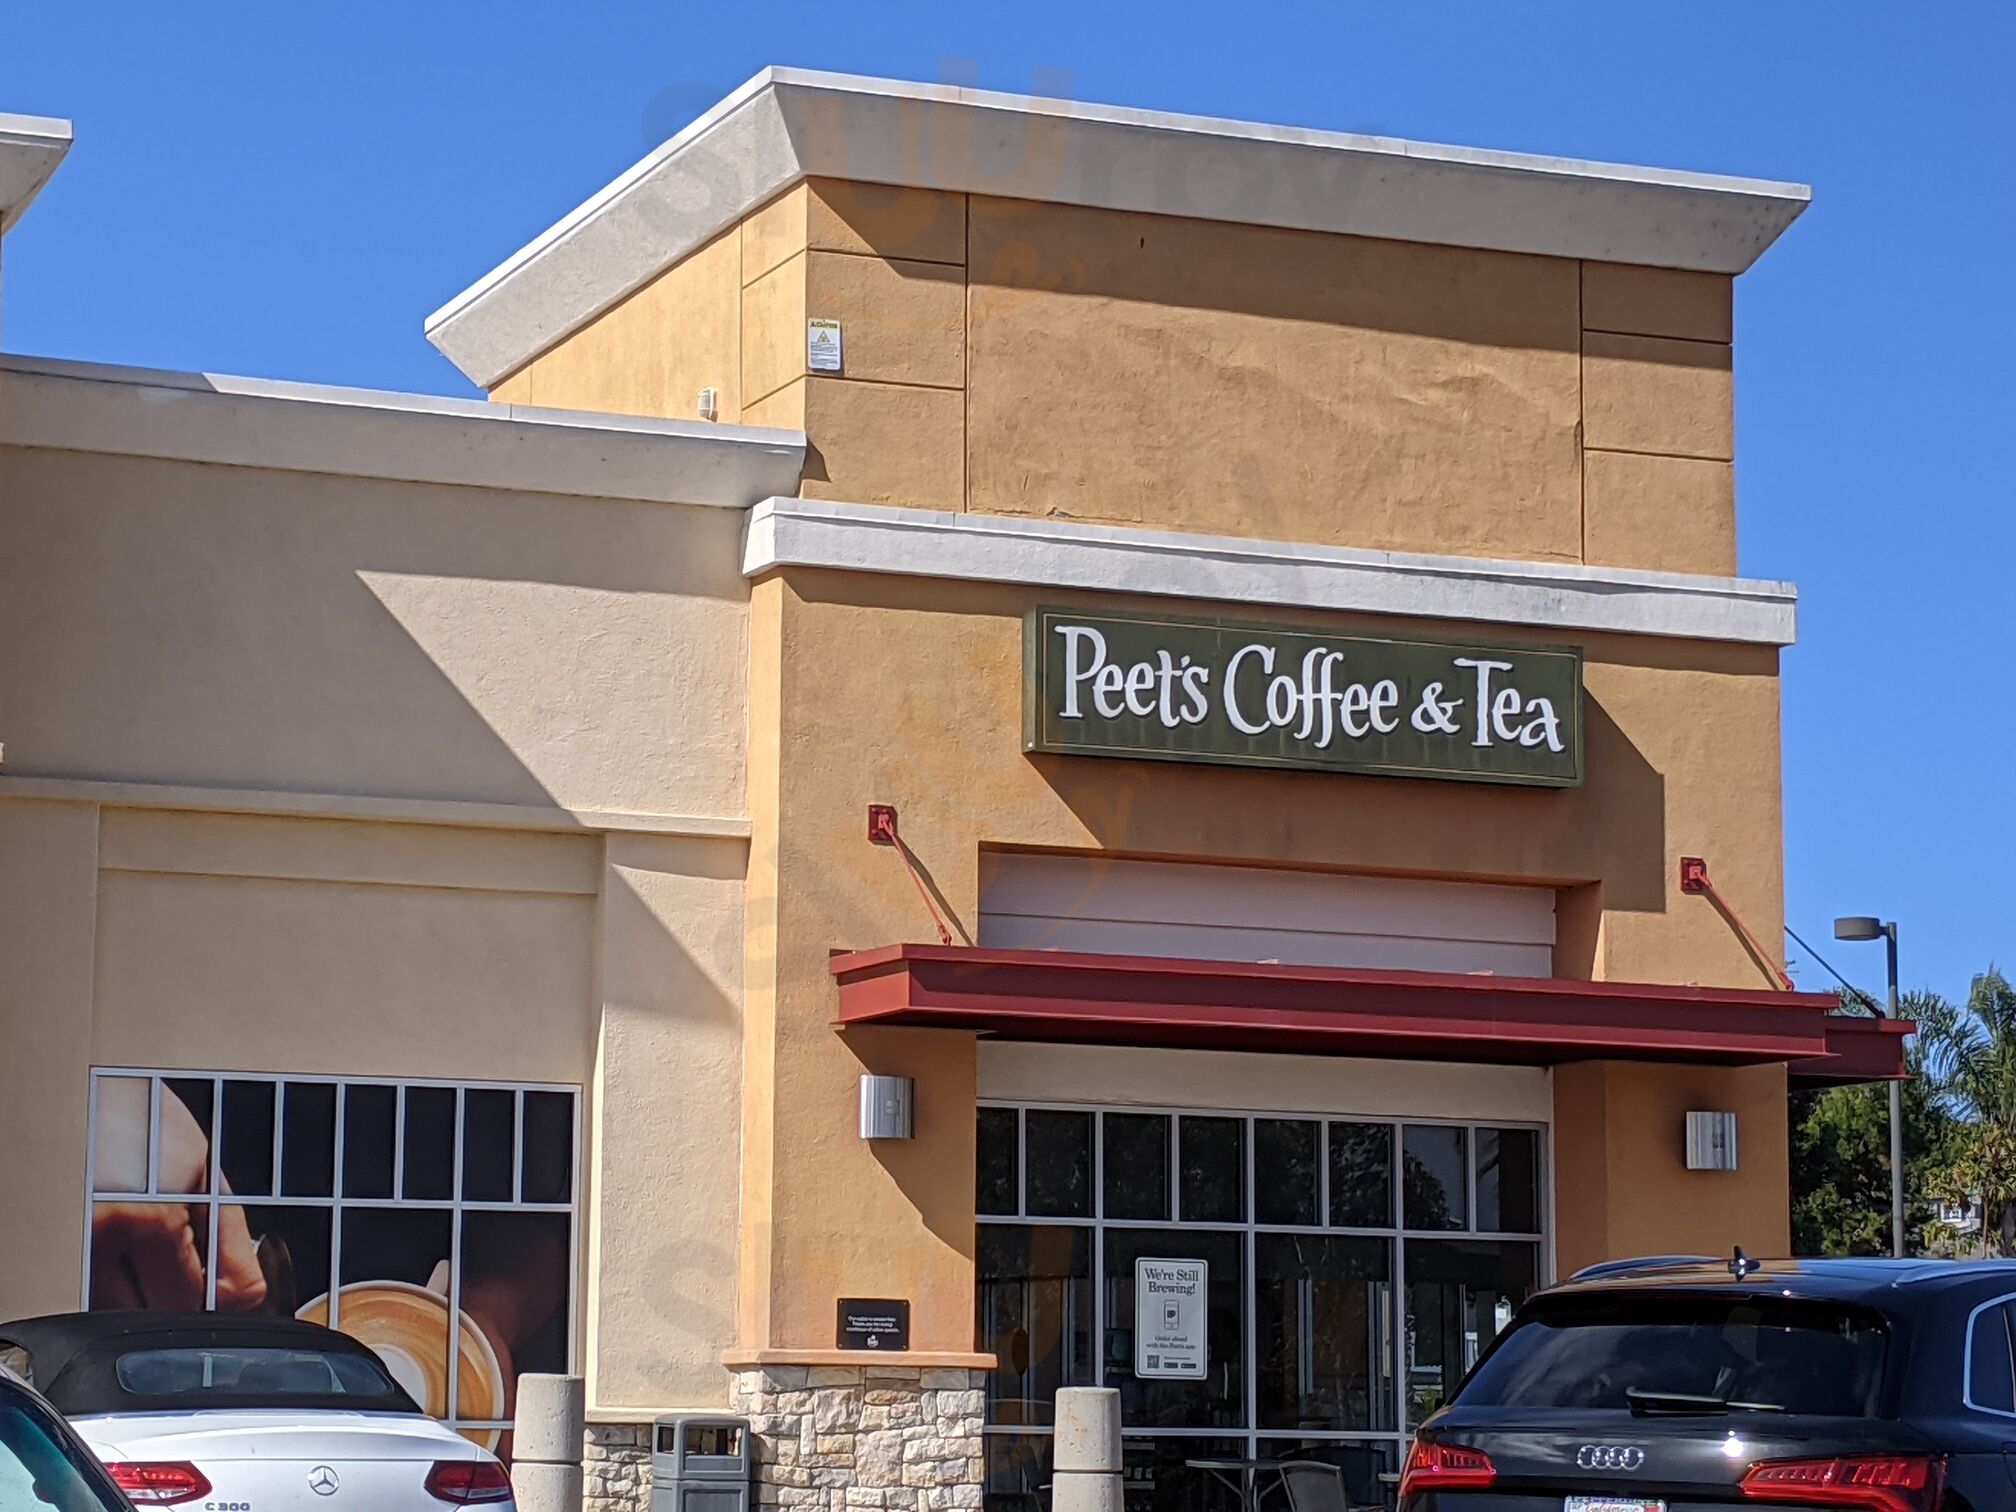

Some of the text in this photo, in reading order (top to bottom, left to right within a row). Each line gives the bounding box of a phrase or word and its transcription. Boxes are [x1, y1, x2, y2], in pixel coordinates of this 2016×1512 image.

[1054, 625, 1567, 753] Peet's Coffee & Tea
[1144, 1268, 1199, 1281] We're Still
[1148, 1281, 1196, 1296] Brewing!
[205, 1502, 251, 1511] C 300
